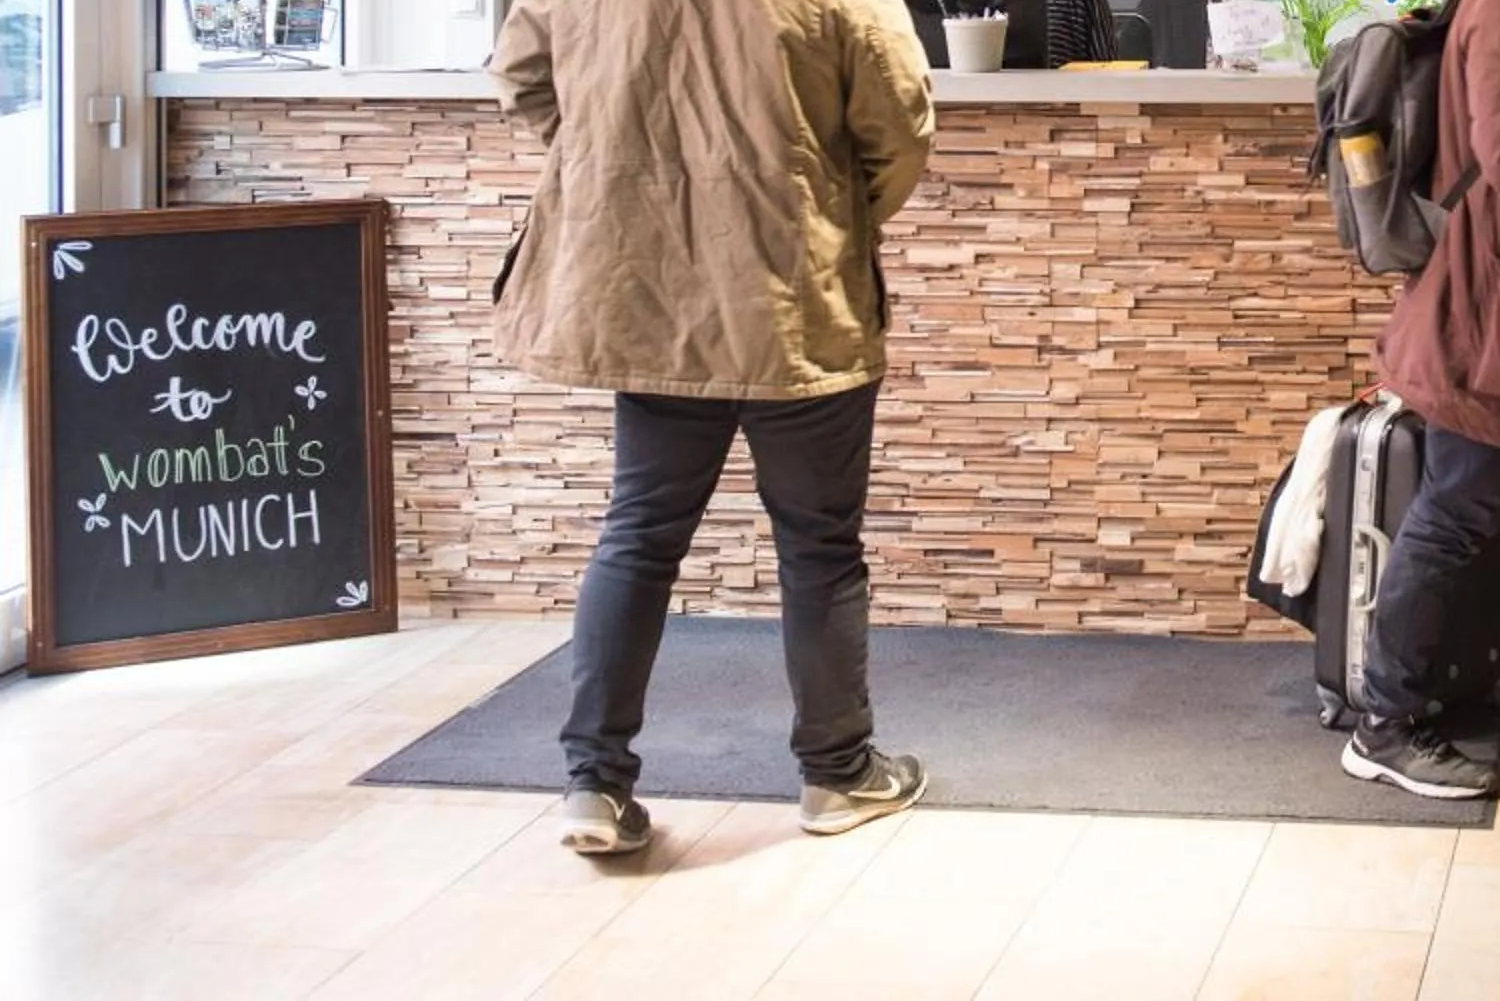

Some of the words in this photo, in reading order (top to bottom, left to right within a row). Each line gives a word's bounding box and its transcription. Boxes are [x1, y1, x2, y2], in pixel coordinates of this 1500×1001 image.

[72, 303, 327, 382] Welcome
[148, 376, 232, 422] to
[99, 415, 326, 493] wombat's
[121, 489, 322, 568] MUNICH
